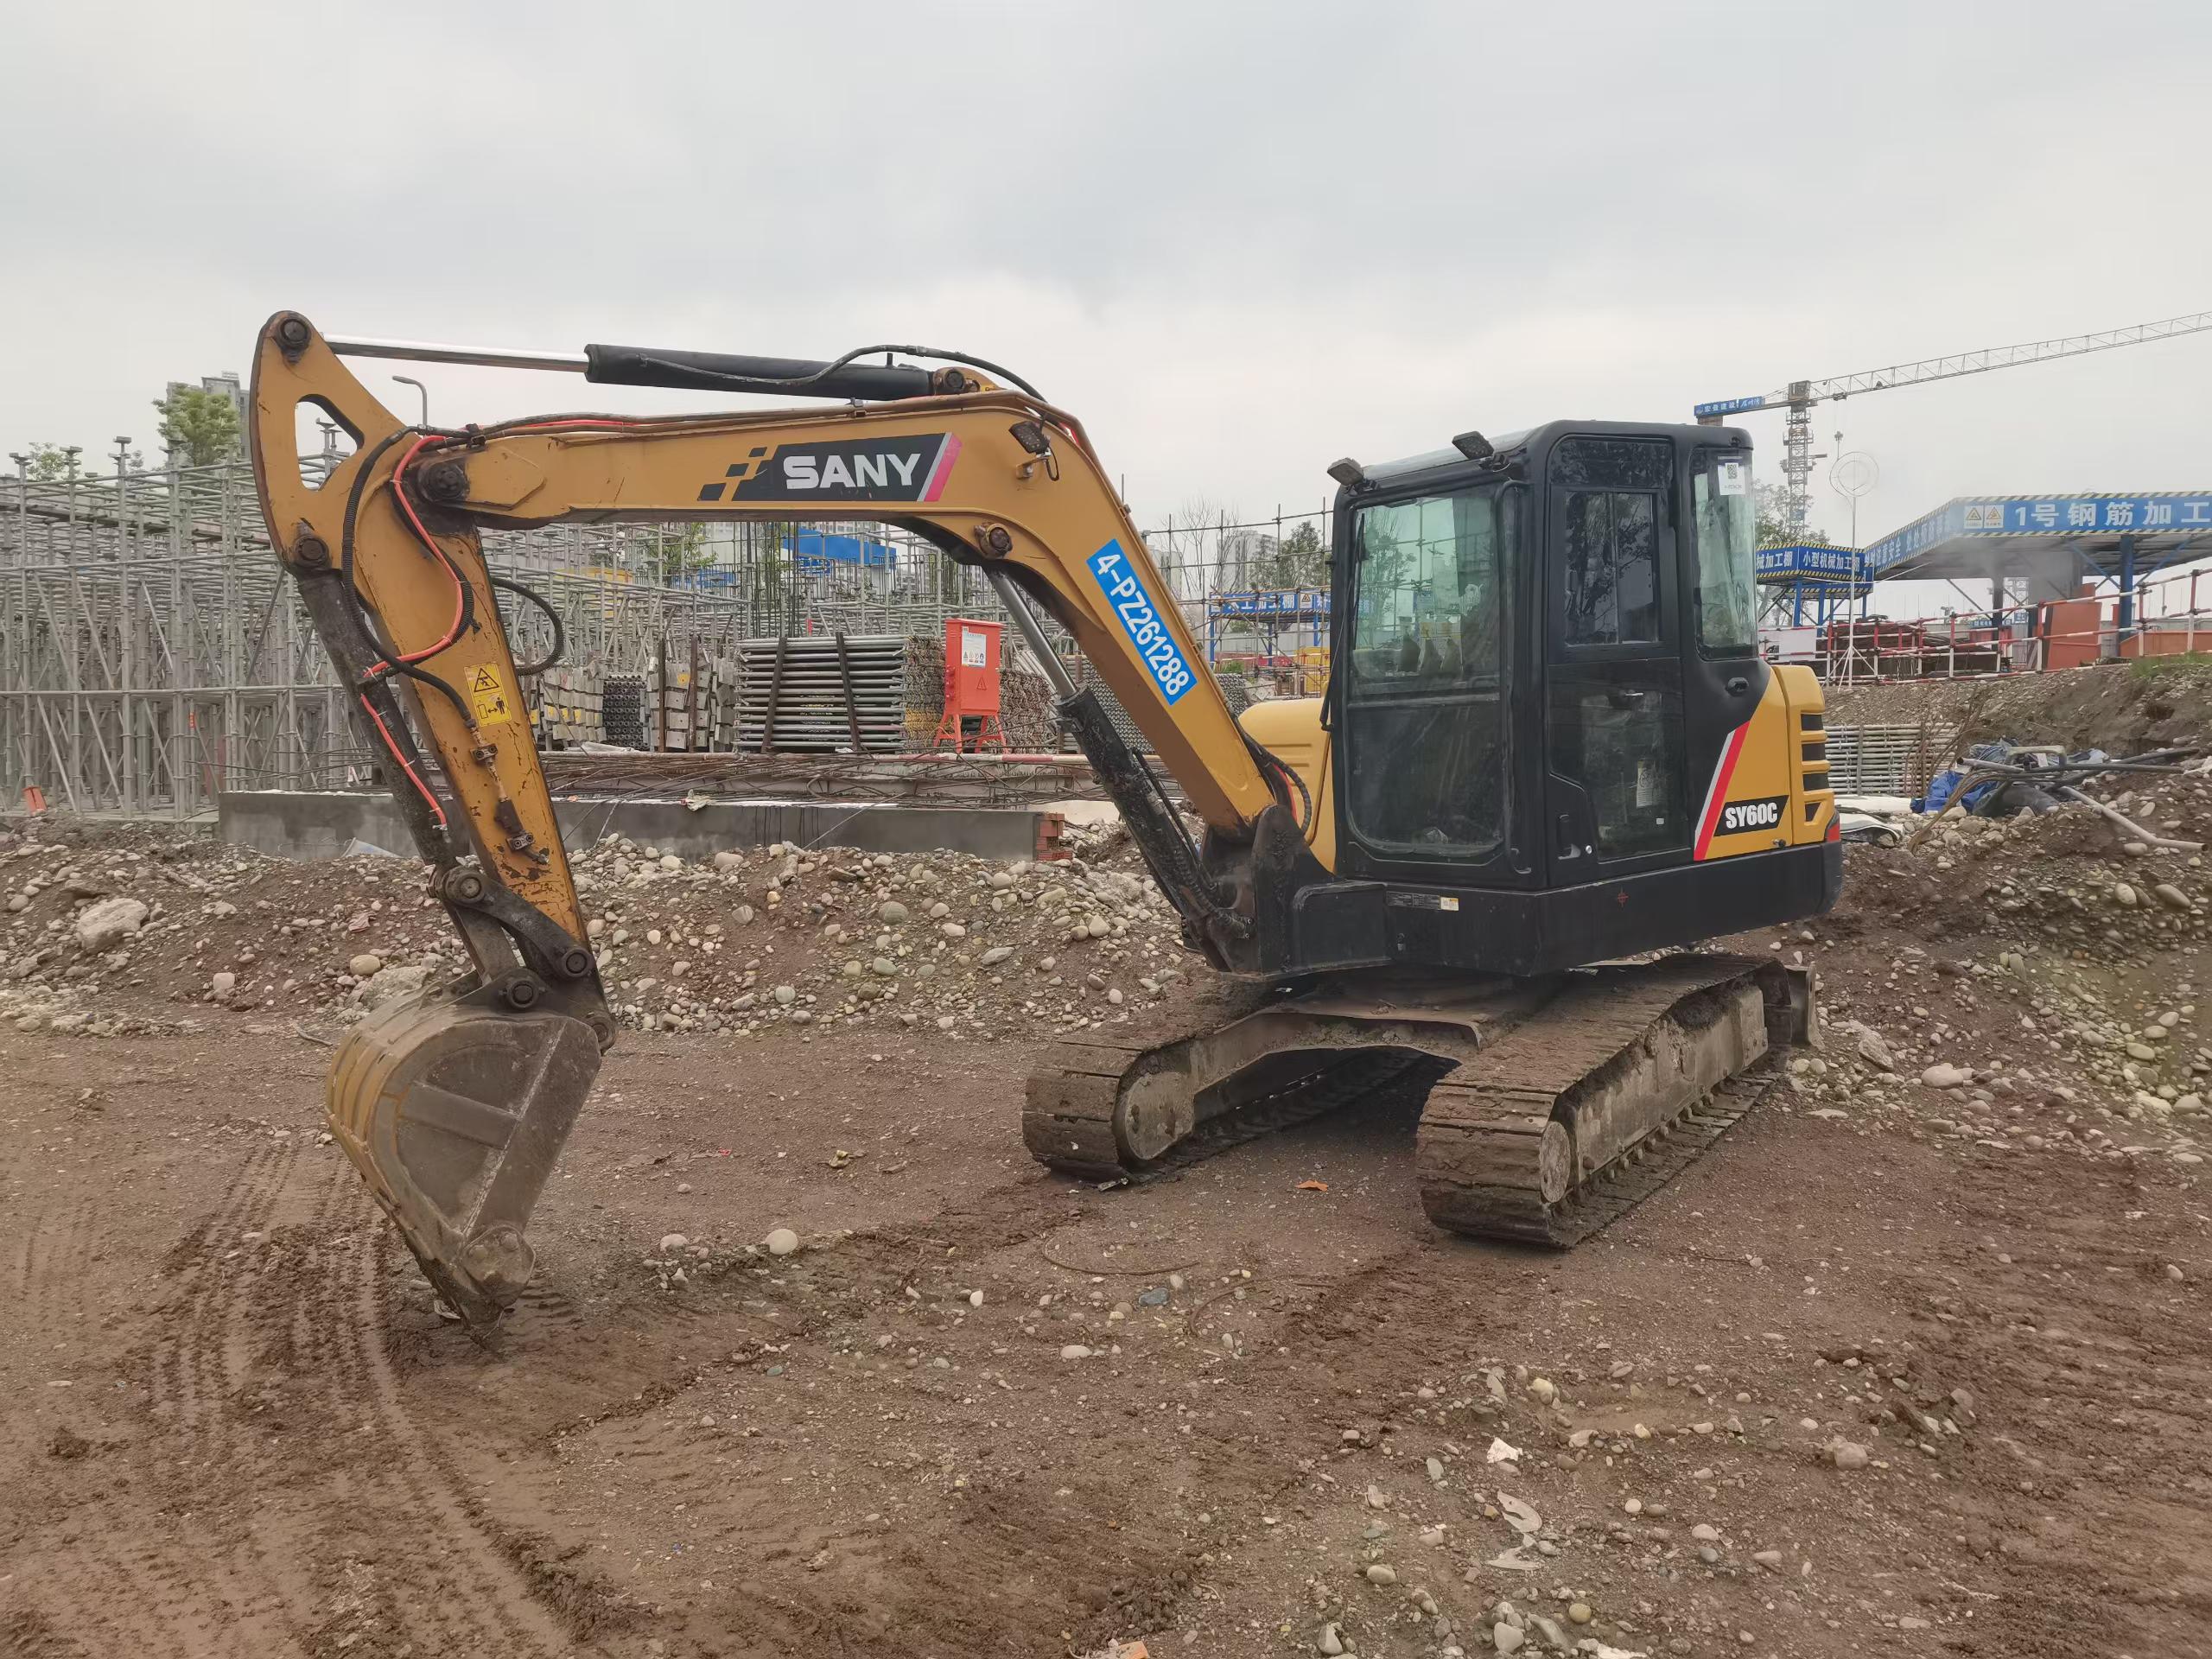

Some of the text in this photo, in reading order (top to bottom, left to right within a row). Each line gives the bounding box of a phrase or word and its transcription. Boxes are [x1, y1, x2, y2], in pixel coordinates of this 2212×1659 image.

[784, 454, 921, 489] SANY
[2014, 501, 2211, 527] 1号钢筋加工
[1802, 550, 1860, 572] 小型机械加工棚
[1097, 554, 1189, 696] 4-PZ261288
[1725, 802, 1778, 830] SY60C
